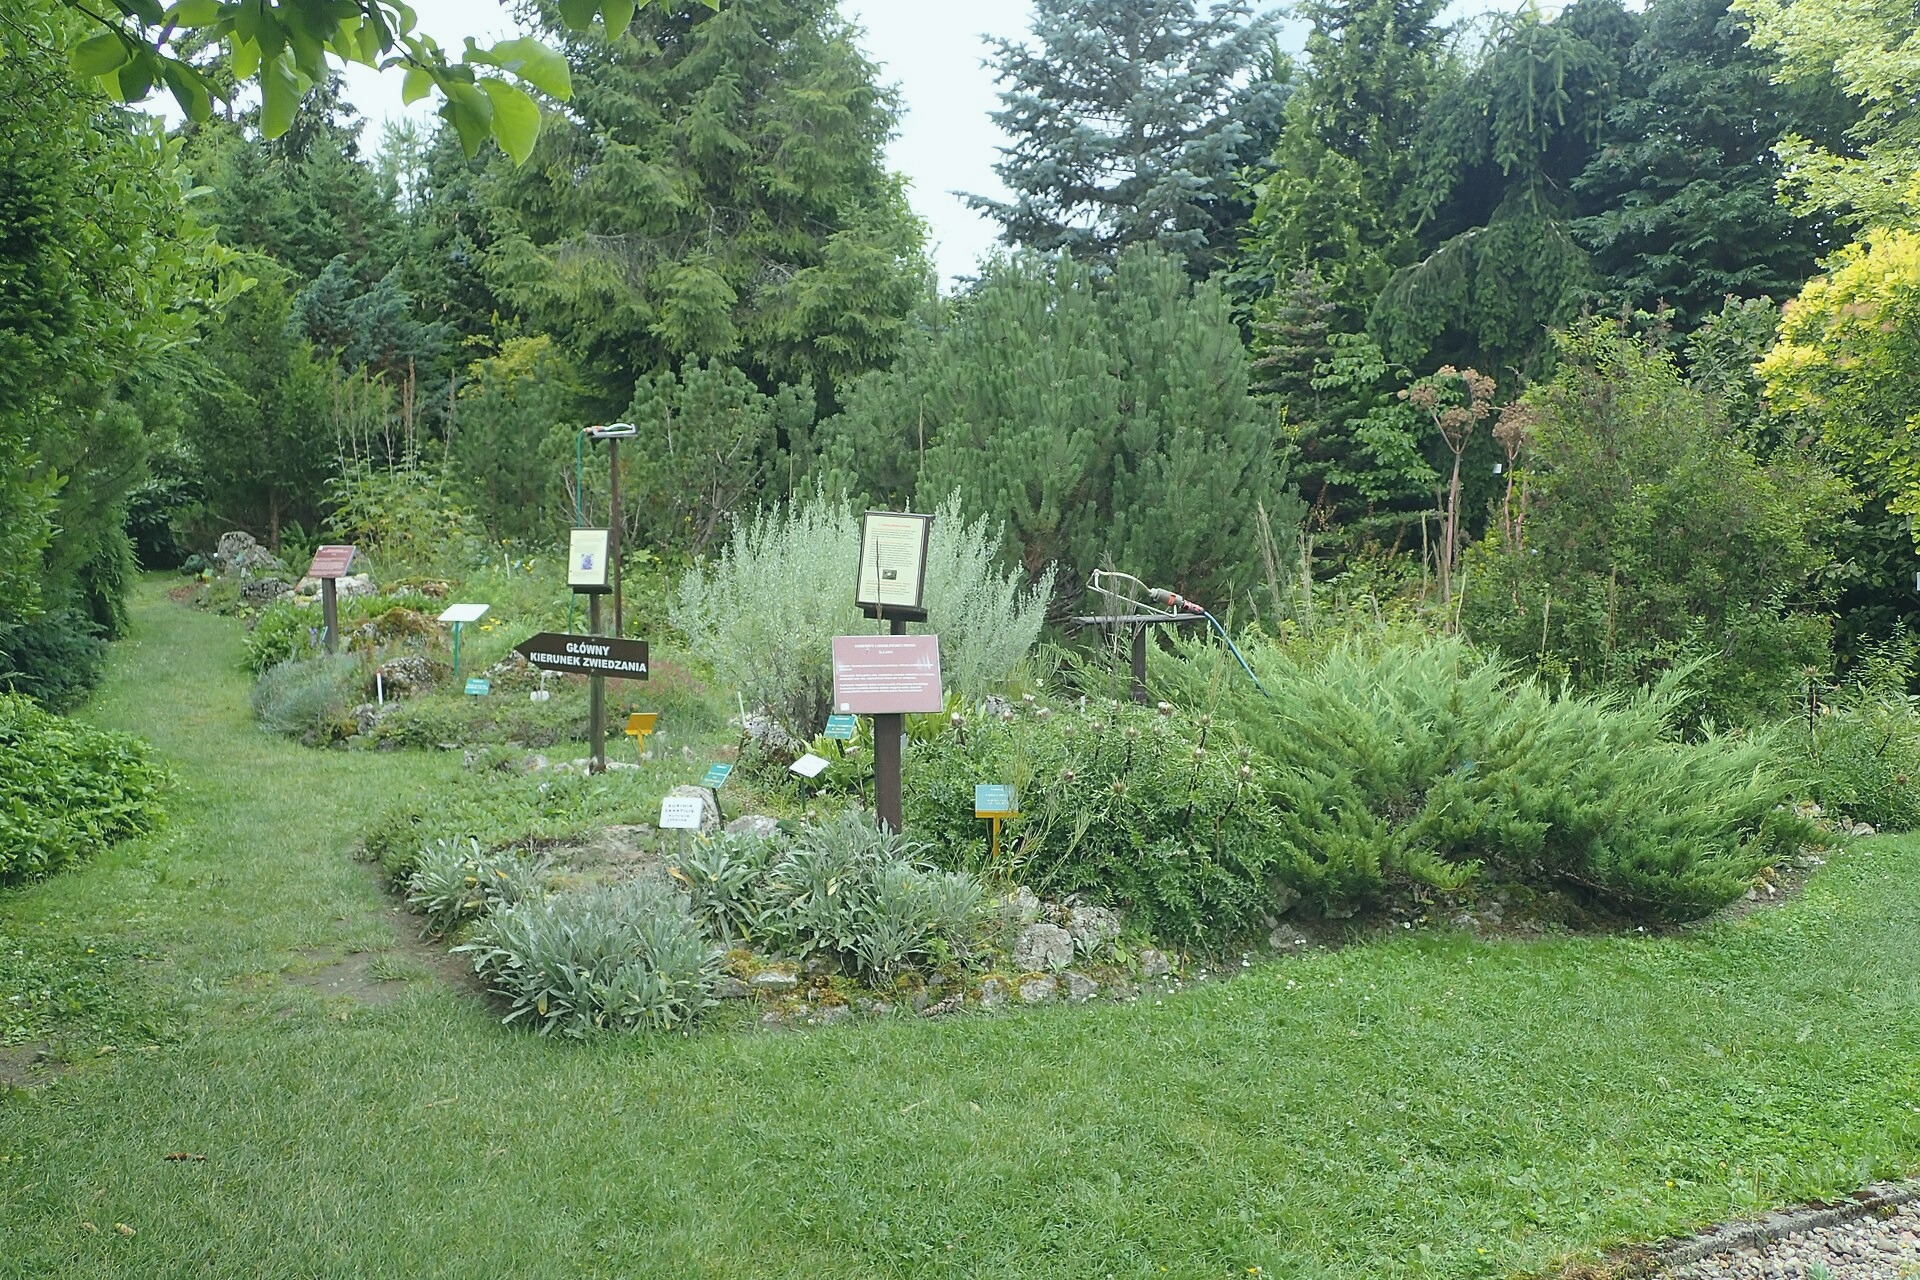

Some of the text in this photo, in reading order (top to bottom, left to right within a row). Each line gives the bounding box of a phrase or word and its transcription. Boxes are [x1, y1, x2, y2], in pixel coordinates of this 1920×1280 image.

[566, 642, 610, 656] GŁÓWNY
[530, 652, 647, 673] KIERUNEK ZWIEDZANIA
